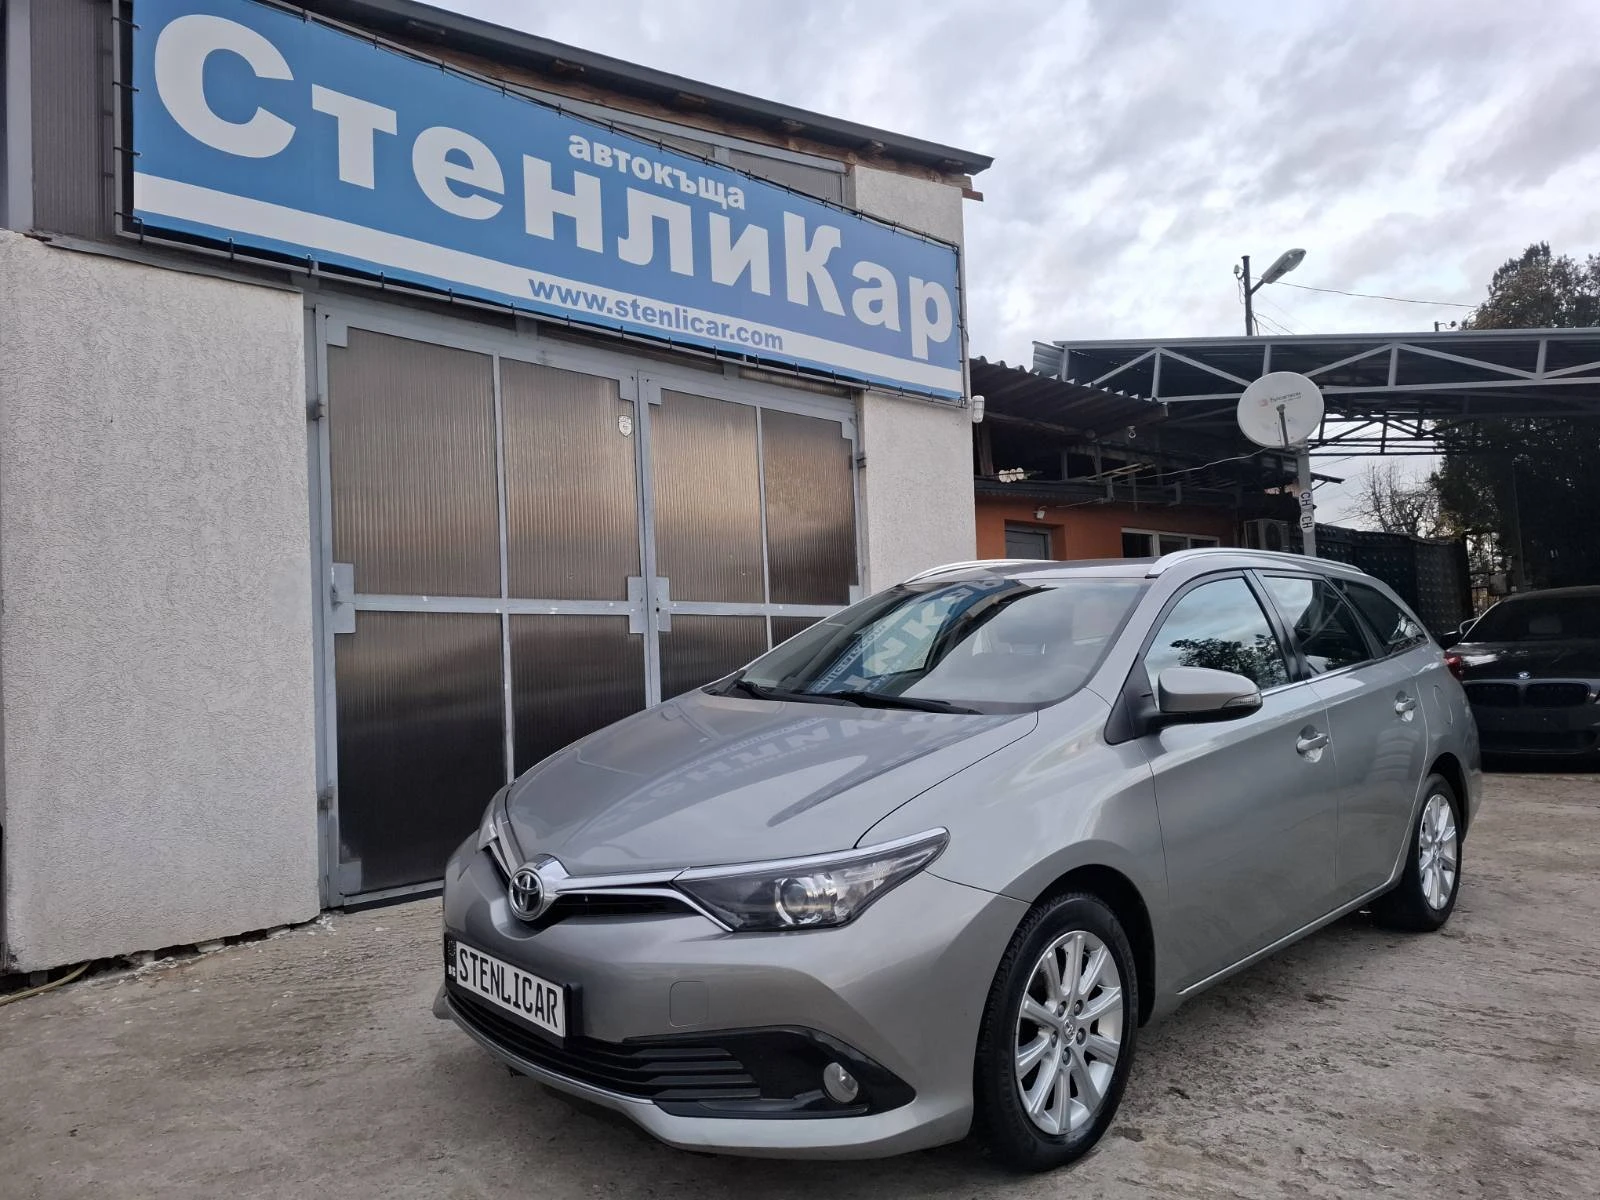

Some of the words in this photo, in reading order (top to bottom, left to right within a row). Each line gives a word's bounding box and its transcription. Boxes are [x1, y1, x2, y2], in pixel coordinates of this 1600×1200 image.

[154, 14, 953, 361] СтенлиКар
[568, 134, 745, 210] автокъща
[528, 278, 784, 351] www.stenlicar.com
[459, 947, 559, 1029] STENLICAR
